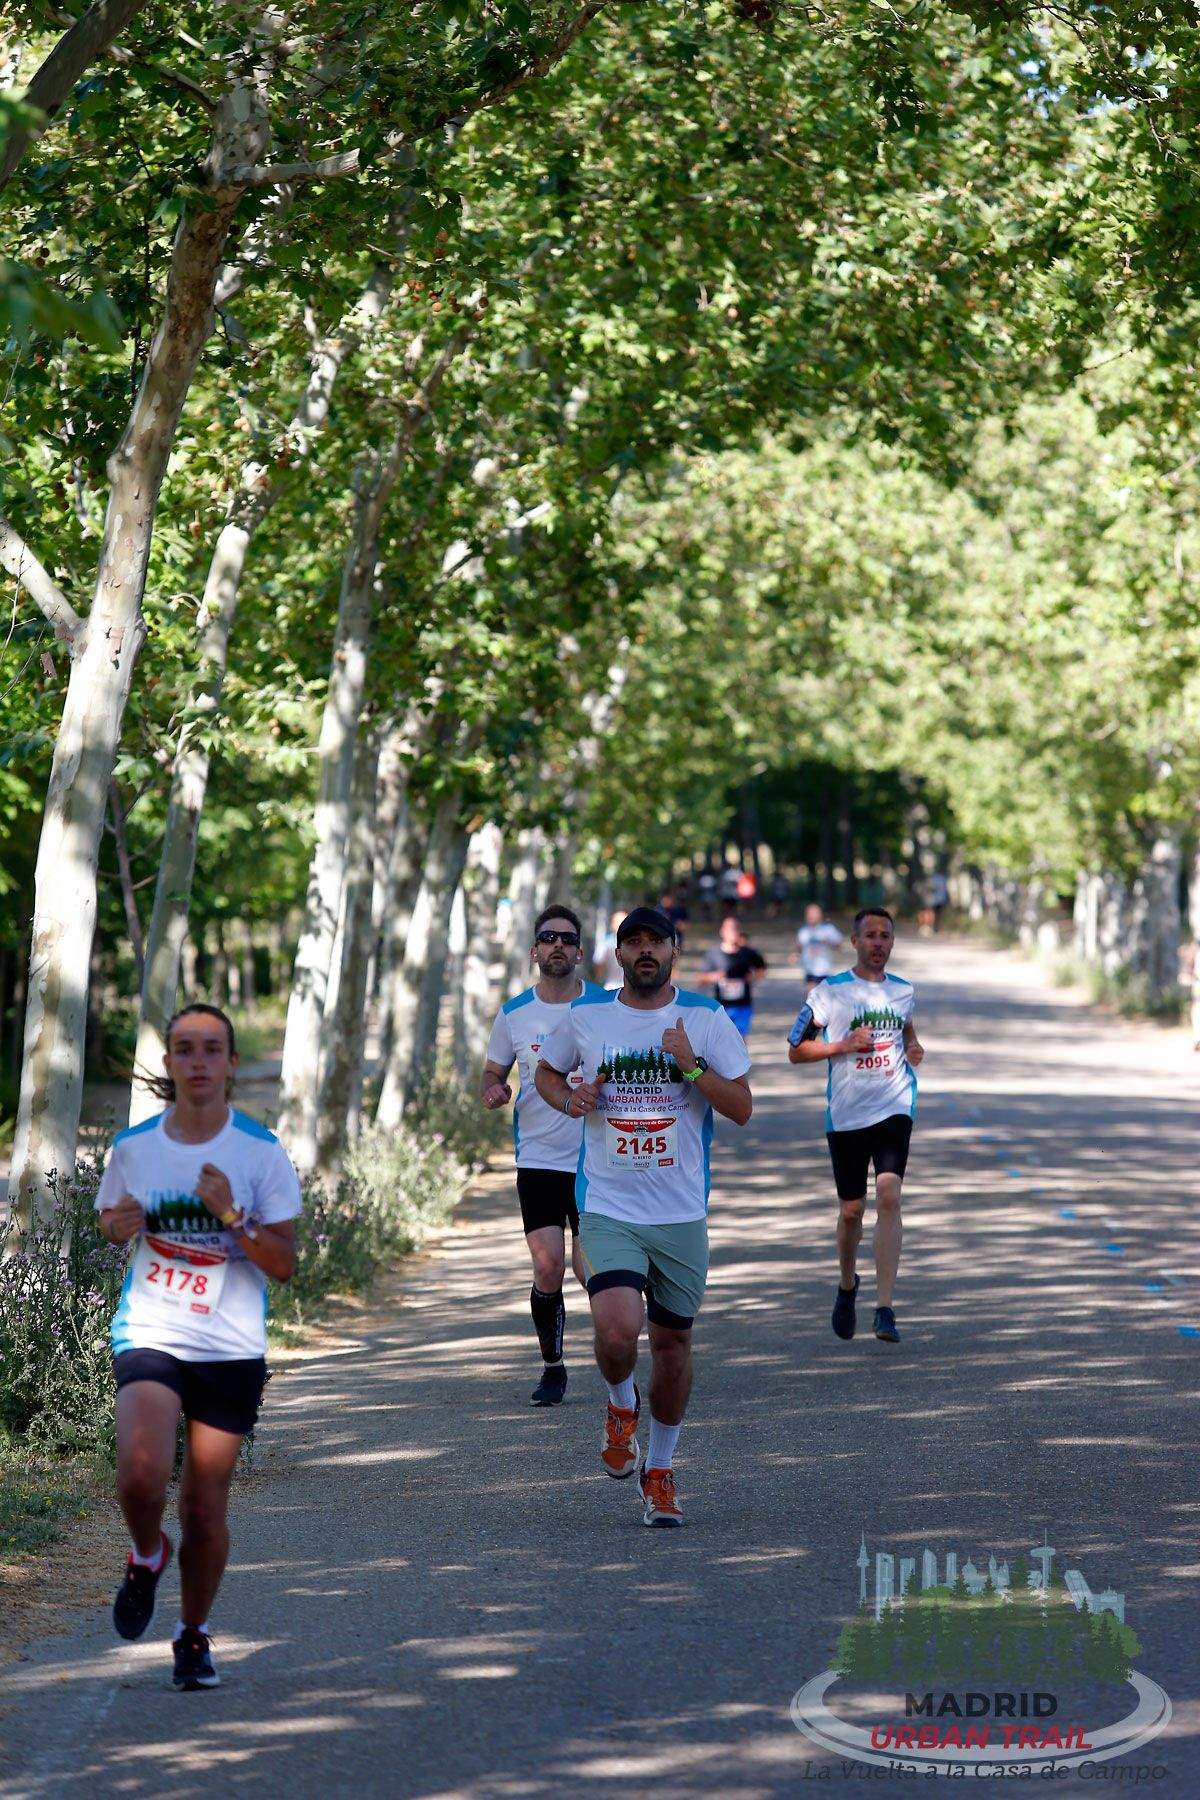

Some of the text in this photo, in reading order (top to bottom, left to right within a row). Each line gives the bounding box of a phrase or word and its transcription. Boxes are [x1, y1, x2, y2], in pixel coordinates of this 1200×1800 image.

[856, 1054, 890, 1070] 2095
[616, 1086, 663, 1095] MADRID
[608, 1095, 673, 1104] URBAN TRAIL
[629, 1105, 637, 1113] la
[638, 1105, 656, 1113] Casa
[667, 1103, 690, 1112] Campo
[616, 1136, 667, 1155] 2145
[146, 1261, 208, 1295] 2178
